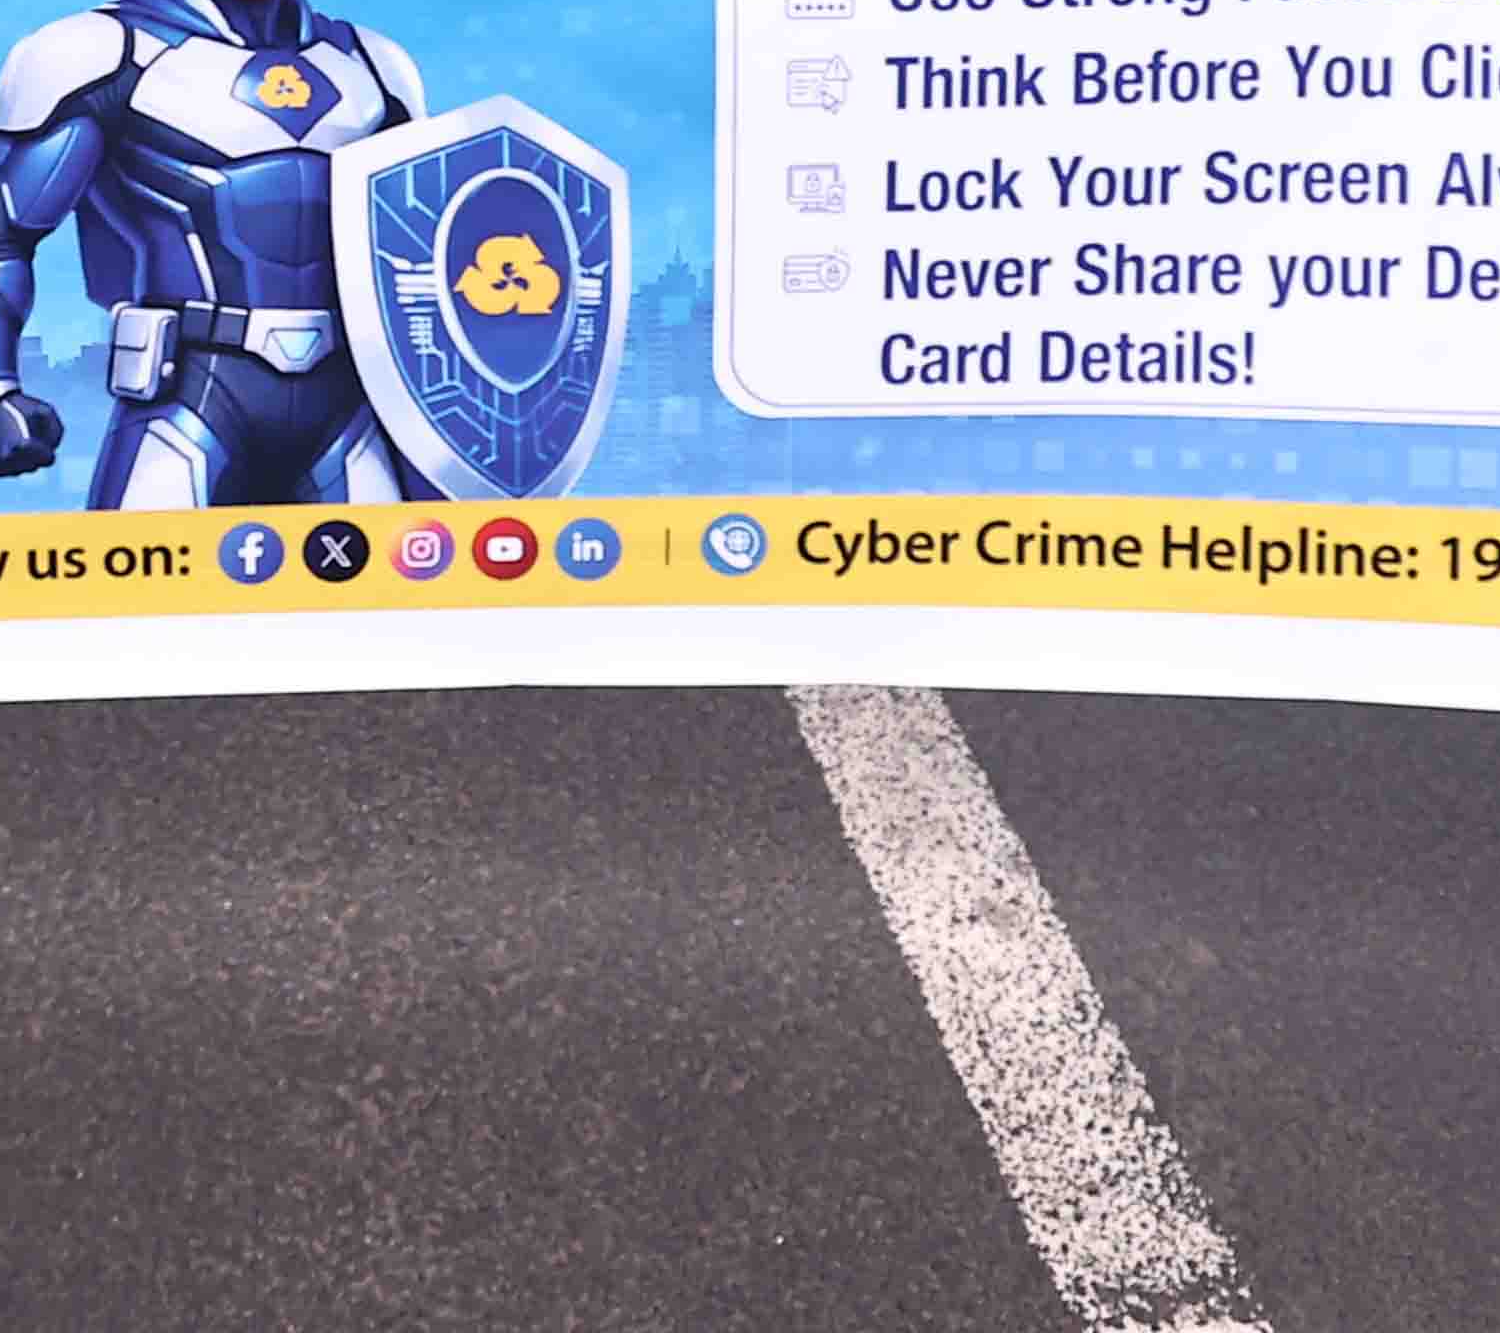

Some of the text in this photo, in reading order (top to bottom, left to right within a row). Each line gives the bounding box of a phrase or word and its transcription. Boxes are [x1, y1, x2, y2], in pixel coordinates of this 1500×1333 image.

[885, 54, 1046, 110] Think
[1073, 49, 1260, 105] Before
[1286, 44, 1392, 98] You
[886, 157, 1022, 212] Lock
[1048, 155, 1182, 208] Your
[1204, 150, 1408, 205] Screen
[884, 248, 1052, 300] Never
[1074, 242, 1241, 296] Share
[1268, 254, 1401, 309] your
[881, 330, 1253, 385] Card Details!
[27, 547, 87, 580] us
[103, 545, 190, 578] on:
[797, 518, 960, 577] Cyber
[976, 520, 1143, 568] Crime
[1162, 524, 1418, 586] Helpline:
